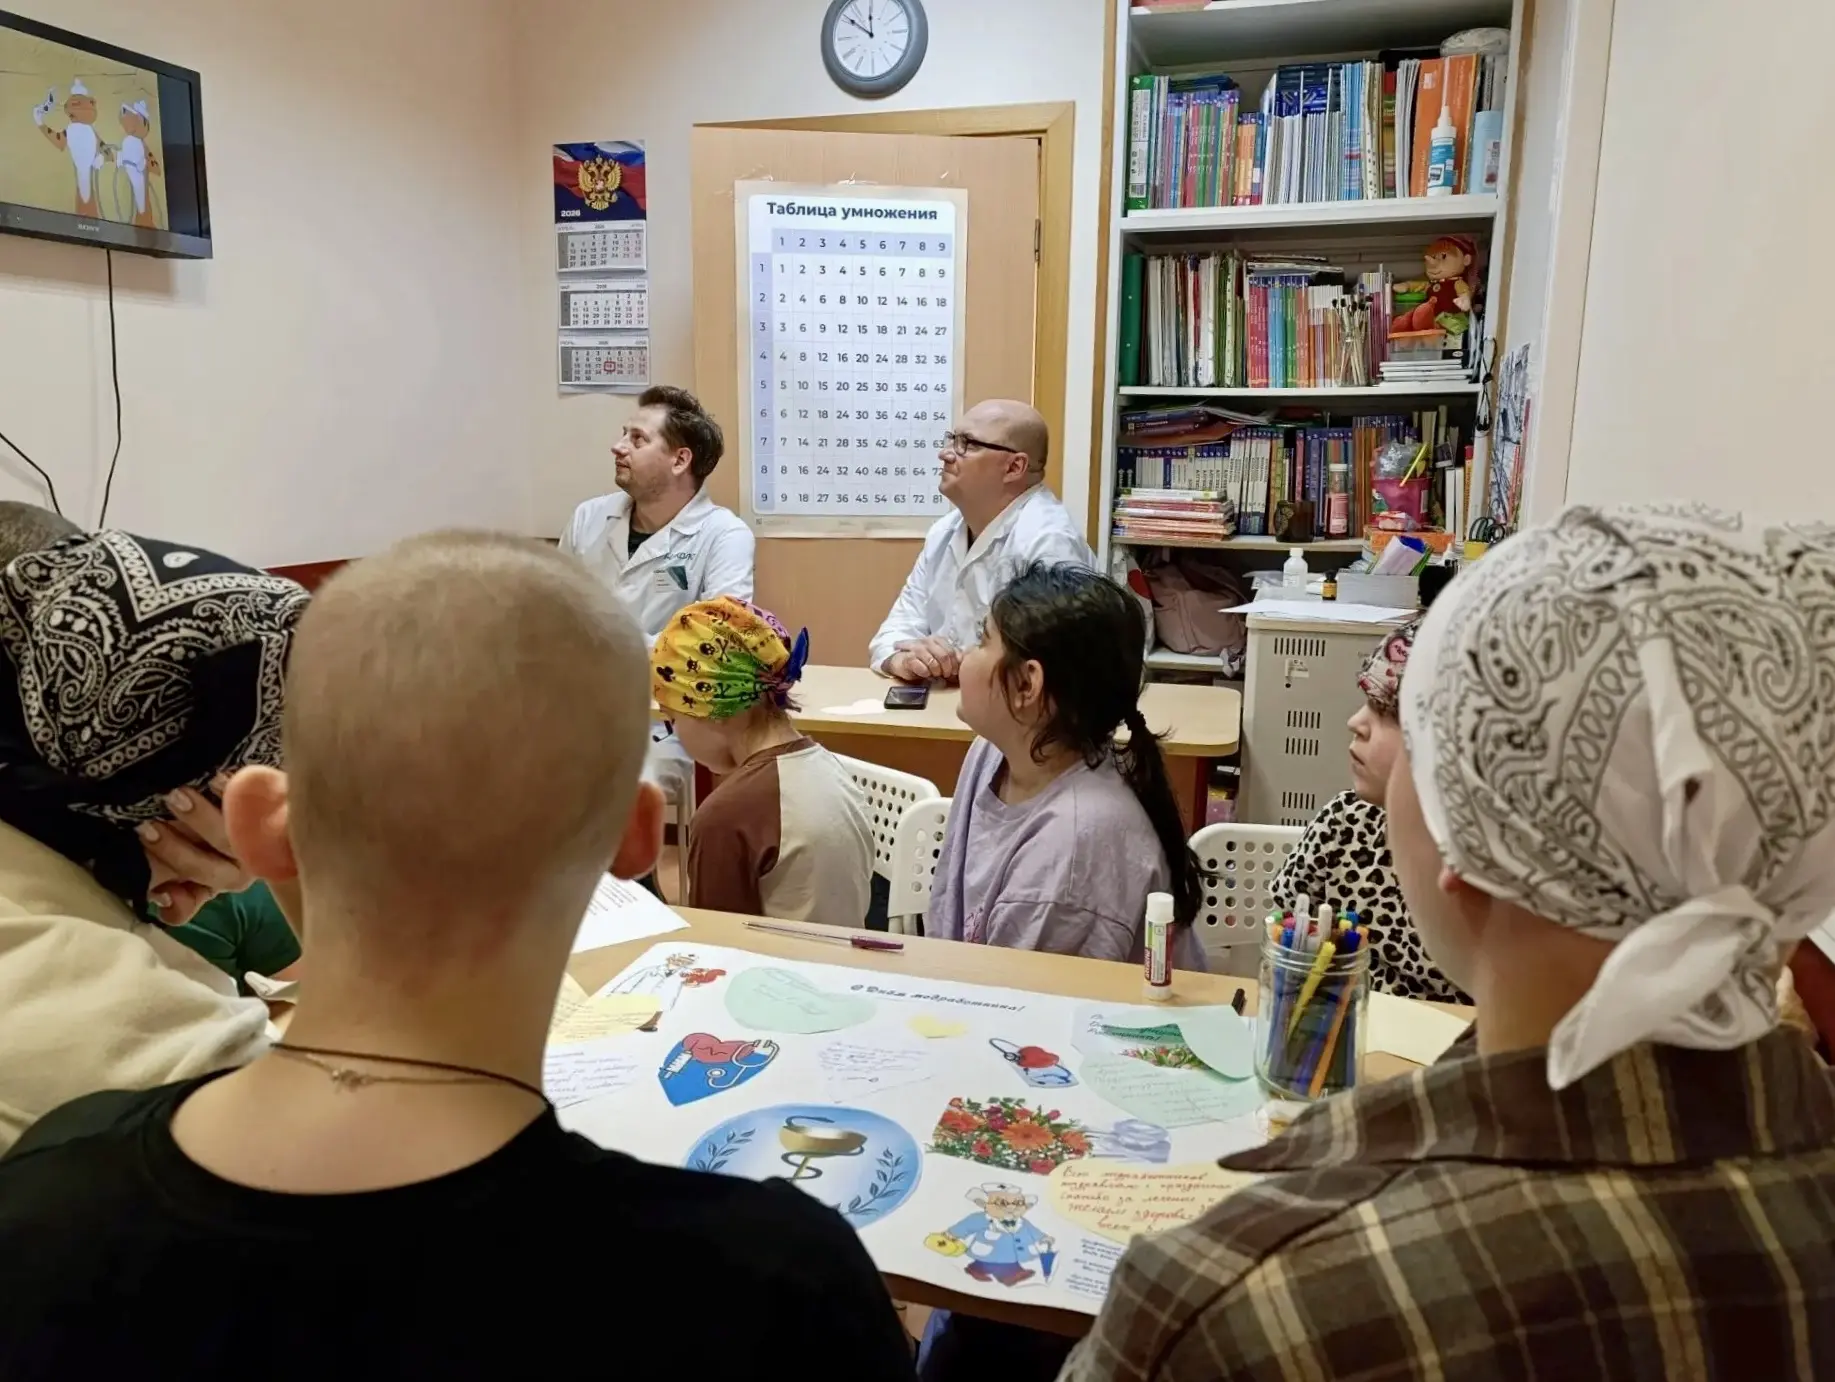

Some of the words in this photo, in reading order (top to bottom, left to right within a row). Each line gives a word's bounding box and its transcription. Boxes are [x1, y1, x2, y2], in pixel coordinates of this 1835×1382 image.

[766, 202, 837, 217] Таблица
[841, 206, 938, 220] умножения
[780, 236, 784, 246] 1
[799, 237, 806, 247] 2
[819, 238, 826, 248] 3
[839, 239, 847, 248] 4
[860, 239, 866, 249] 5
[879, 240, 887, 250] 6
[899, 240, 906, 250] 7
[919, 241, 926, 251] 8
[938, 242, 946, 252] 9
[759, 263, 764, 272] 1
[780, 263, 785, 273] 1
[799, 264, 806, 274] 2
[819, 265, 826, 275] 3
[839, 266, 847, 275] 4
[859, 266, 866, 276] 5
[879, 267, 886, 277] 6
[899, 267, 906, 277] 7
[918, 268, 926, 278] 8
[938, 268, 946, 278] 9
[759, 292, 766, 302] 2
[779, 293, 786, 303] 2
[799, 294, 807, 303] 4
[819, 294, 827, 304] 6
[839, 295, 847, 305] 8
[857, 295, 868, 305] 10
[877, 296, 888, 306] 12
[897, 296, 908, 306] 14
[916, 297, 928, 307] 16
[935, 297, 947, 307] 18
[759, 321, 766, 332] 3
[780, 322, 786, 332] 3
[799, 323, 807, 333] 6
[819, 323, 826, 333] 9
[838, 324, 848, 334] 12
[857, 324, 868, 334] 15
[876, 325, 888, 335] 18
[897, 325, 907, 335] 21
[915, 326, 928, 336] 24
[934, 326, 947, 336] 27
[759, 351, 767, 360] 4
[779, 352, 787, 361] 4
[799, 352, 807, 362] 8
[818, 352, 828, 362] 12
[837, 352, 849, 363] 16
[856, 353, 869, 363] 20
[875, 353, 889, 363] 24
[895, 354, 908, 364] 28
[915, 354, 927, 364] 32
[934, 355, 947, 365] 36
[760, 380, 767, 389] 5
[780, 380, 787, 390] 5
[797, 380, 809, 390] 10
[818, 381, 828, 391] 15
[836, 381, 850, 391] 20
[856, 382, 869, 392] 25
[875, 382, 889, 392] 30
[895, 382, 908, 392] 35
[913, 383, 928, 393] 40
[933, 383, 947, 393] 45
[760, 408, 767, 418] 6
[780, 408, 788, 419] 6
[798, 409, 809, 419] 12
[817, 409, 829, 419] 18
[836, 410, 850, 419] 24
[855, 410, 869, 420] 30
[875, 410, 888, 420] 36
[894, 411, 908, 420] 42
[913, 411, 927, 421] 48
[933, 411, 946, 421] 54
[760, 437, 768, 446] 7
[780, 437, 787, 446] 7
[797, 437, 809, 446] 14
[818, 438, 828, 447] 21
[836, 438, 849, 448] 28
[856, 438, 868, 448] 35
[875, 439, 888, 448] 42
[894, 439, 908, 448] 49
[913, 439, 926, 449] 56
[932, 440, 944, 448] 63
[760, 465, 768, 474] 8
[780, 465, 788, 475] 8
[798, 465, 809, 475] 16
[816, 465, 830, 475] 24
[837, 466, 849, 476] 32
[855, 466, 869, 476] 40
[874, 467, 888, 476] 48
[894, 467, 907, 476] 56
[912, 467, 926, 476] 64
[761, 493, 768, 502] 9
[780, 493, 788, 502] 9
[798, 493, 809, 503] 18
[817, 493, 829, 503] 27
[836, 493, 849, 503] 36
[855, 494, 869, 503] 45
[874, 494, 888, 503] 54
[893, 494, 906, 503] 63
[912, 494, 925, 504] 72
[932, 494, 943, 504] 81
